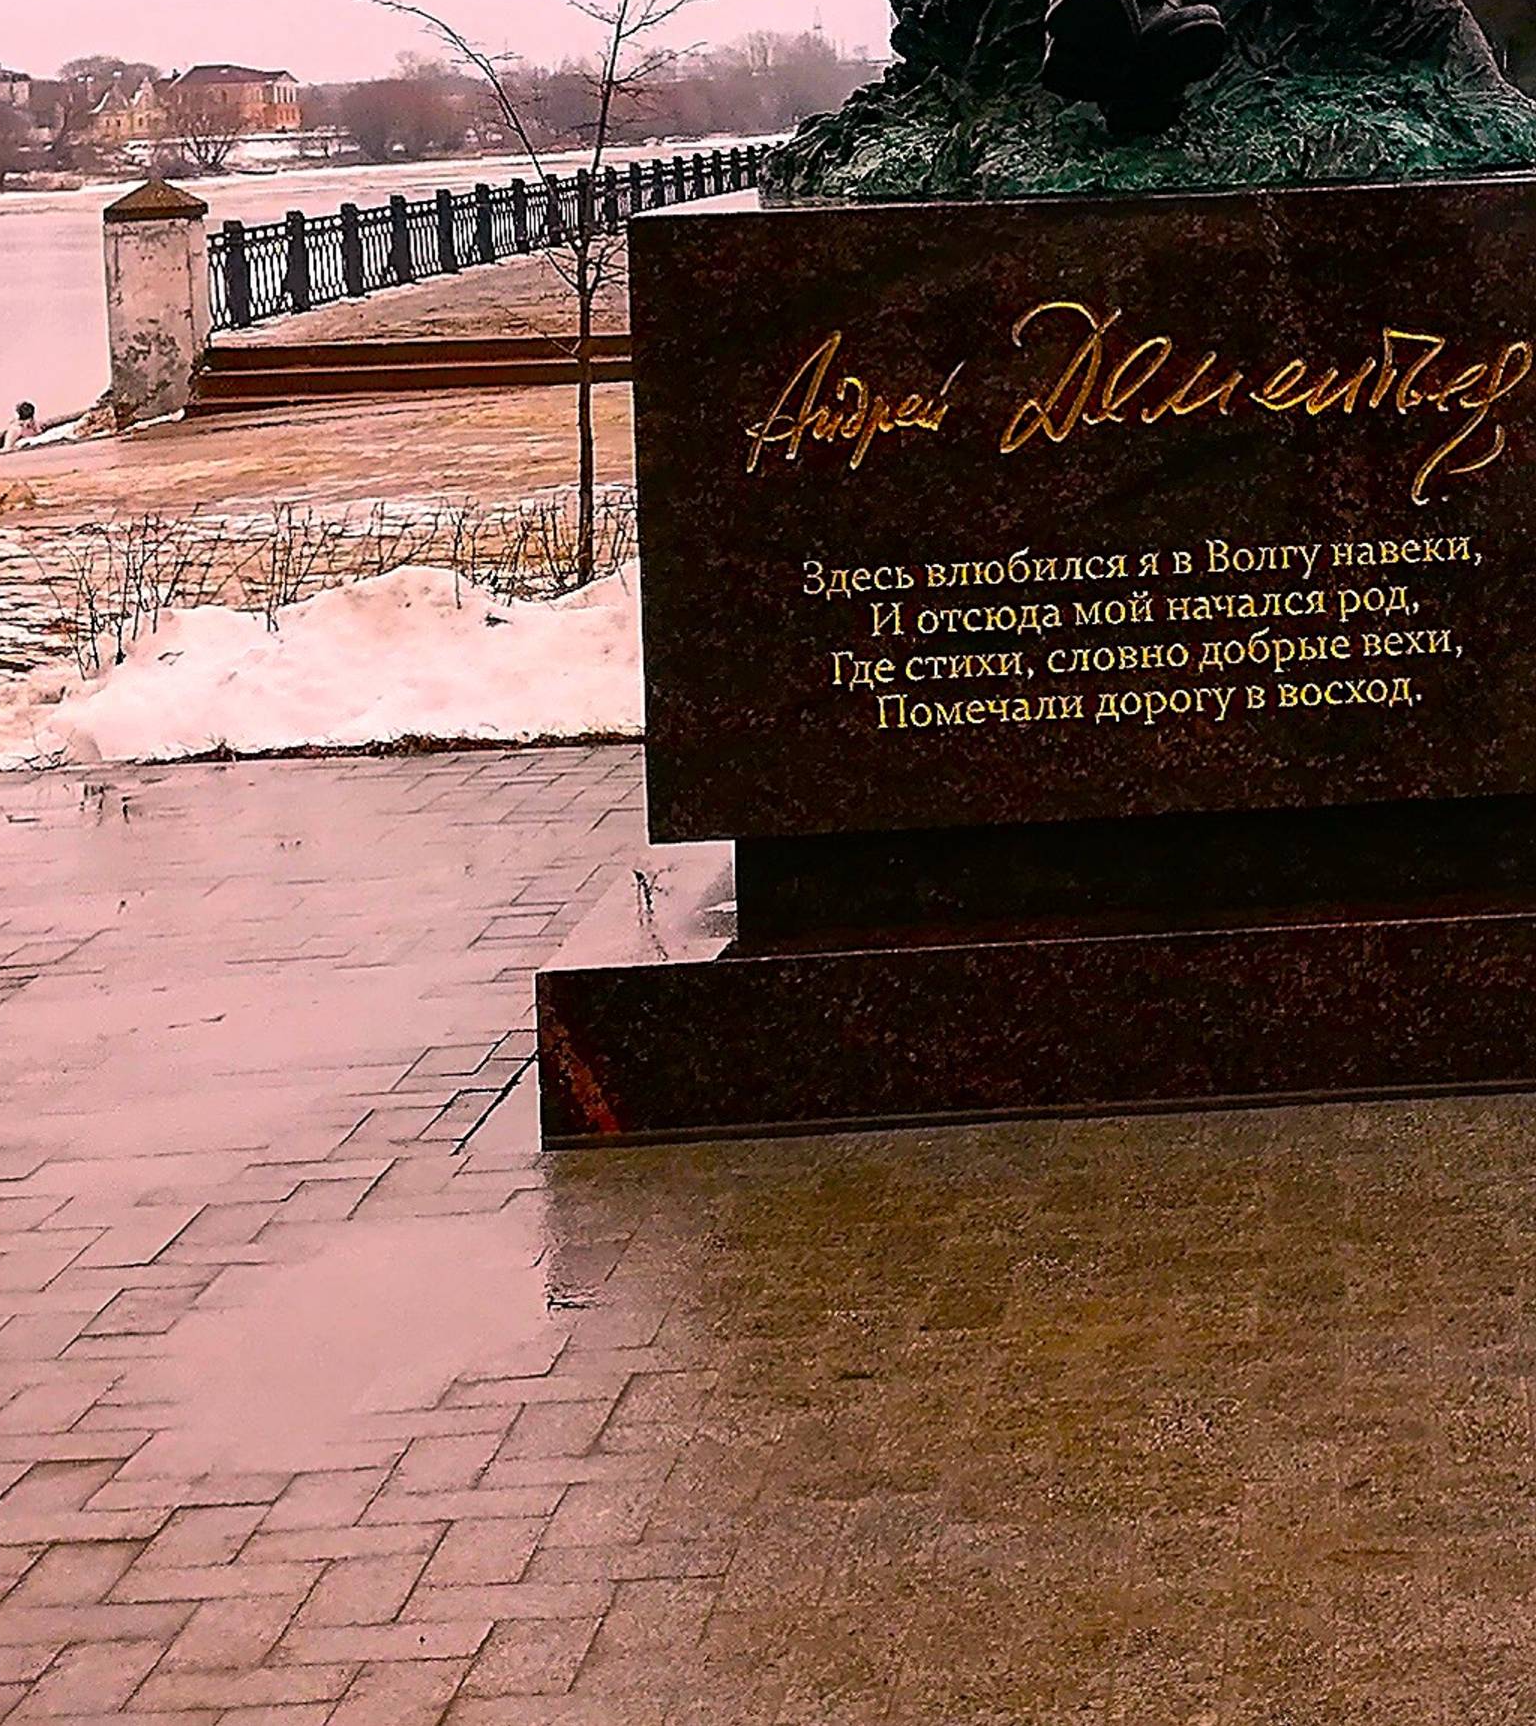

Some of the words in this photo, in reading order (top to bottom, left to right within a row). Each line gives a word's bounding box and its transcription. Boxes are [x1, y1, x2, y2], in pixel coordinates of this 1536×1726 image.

[745, 330, 966, 473] Андрей
[802, 560, 915, 601] Здесь
[924, 546, 1129, 588] влюбился
[1137, 552, 1160, 577] я
[1172, 551, 1193, 575] в
[1205, 539, 1322, 580] Волгу
[1330, 536, 1483, 567] навеки,
[869, 601, 905, 637] И
[917, 603, 1063, 636] отсюда
[1072, 590, 1155, 626] мой
[1166, 590, 1327, 621] начался
[1337, 585, 1420, 624] род,
[830, 650, 897, 692] Где
[905, 651, 1035, 682] стихи,
[1046, 642, 1190, 674] словно
[1198, 619, 1352, 673] добрые
[1360, 629, 1463, 659] вехи,
[875, 693, 1085, 730] Помечали
[1094, 686, 1237, 726] дорогу
[1244, 684, 1266, 709] в
[1276, 667, 1422, 708] восход.
